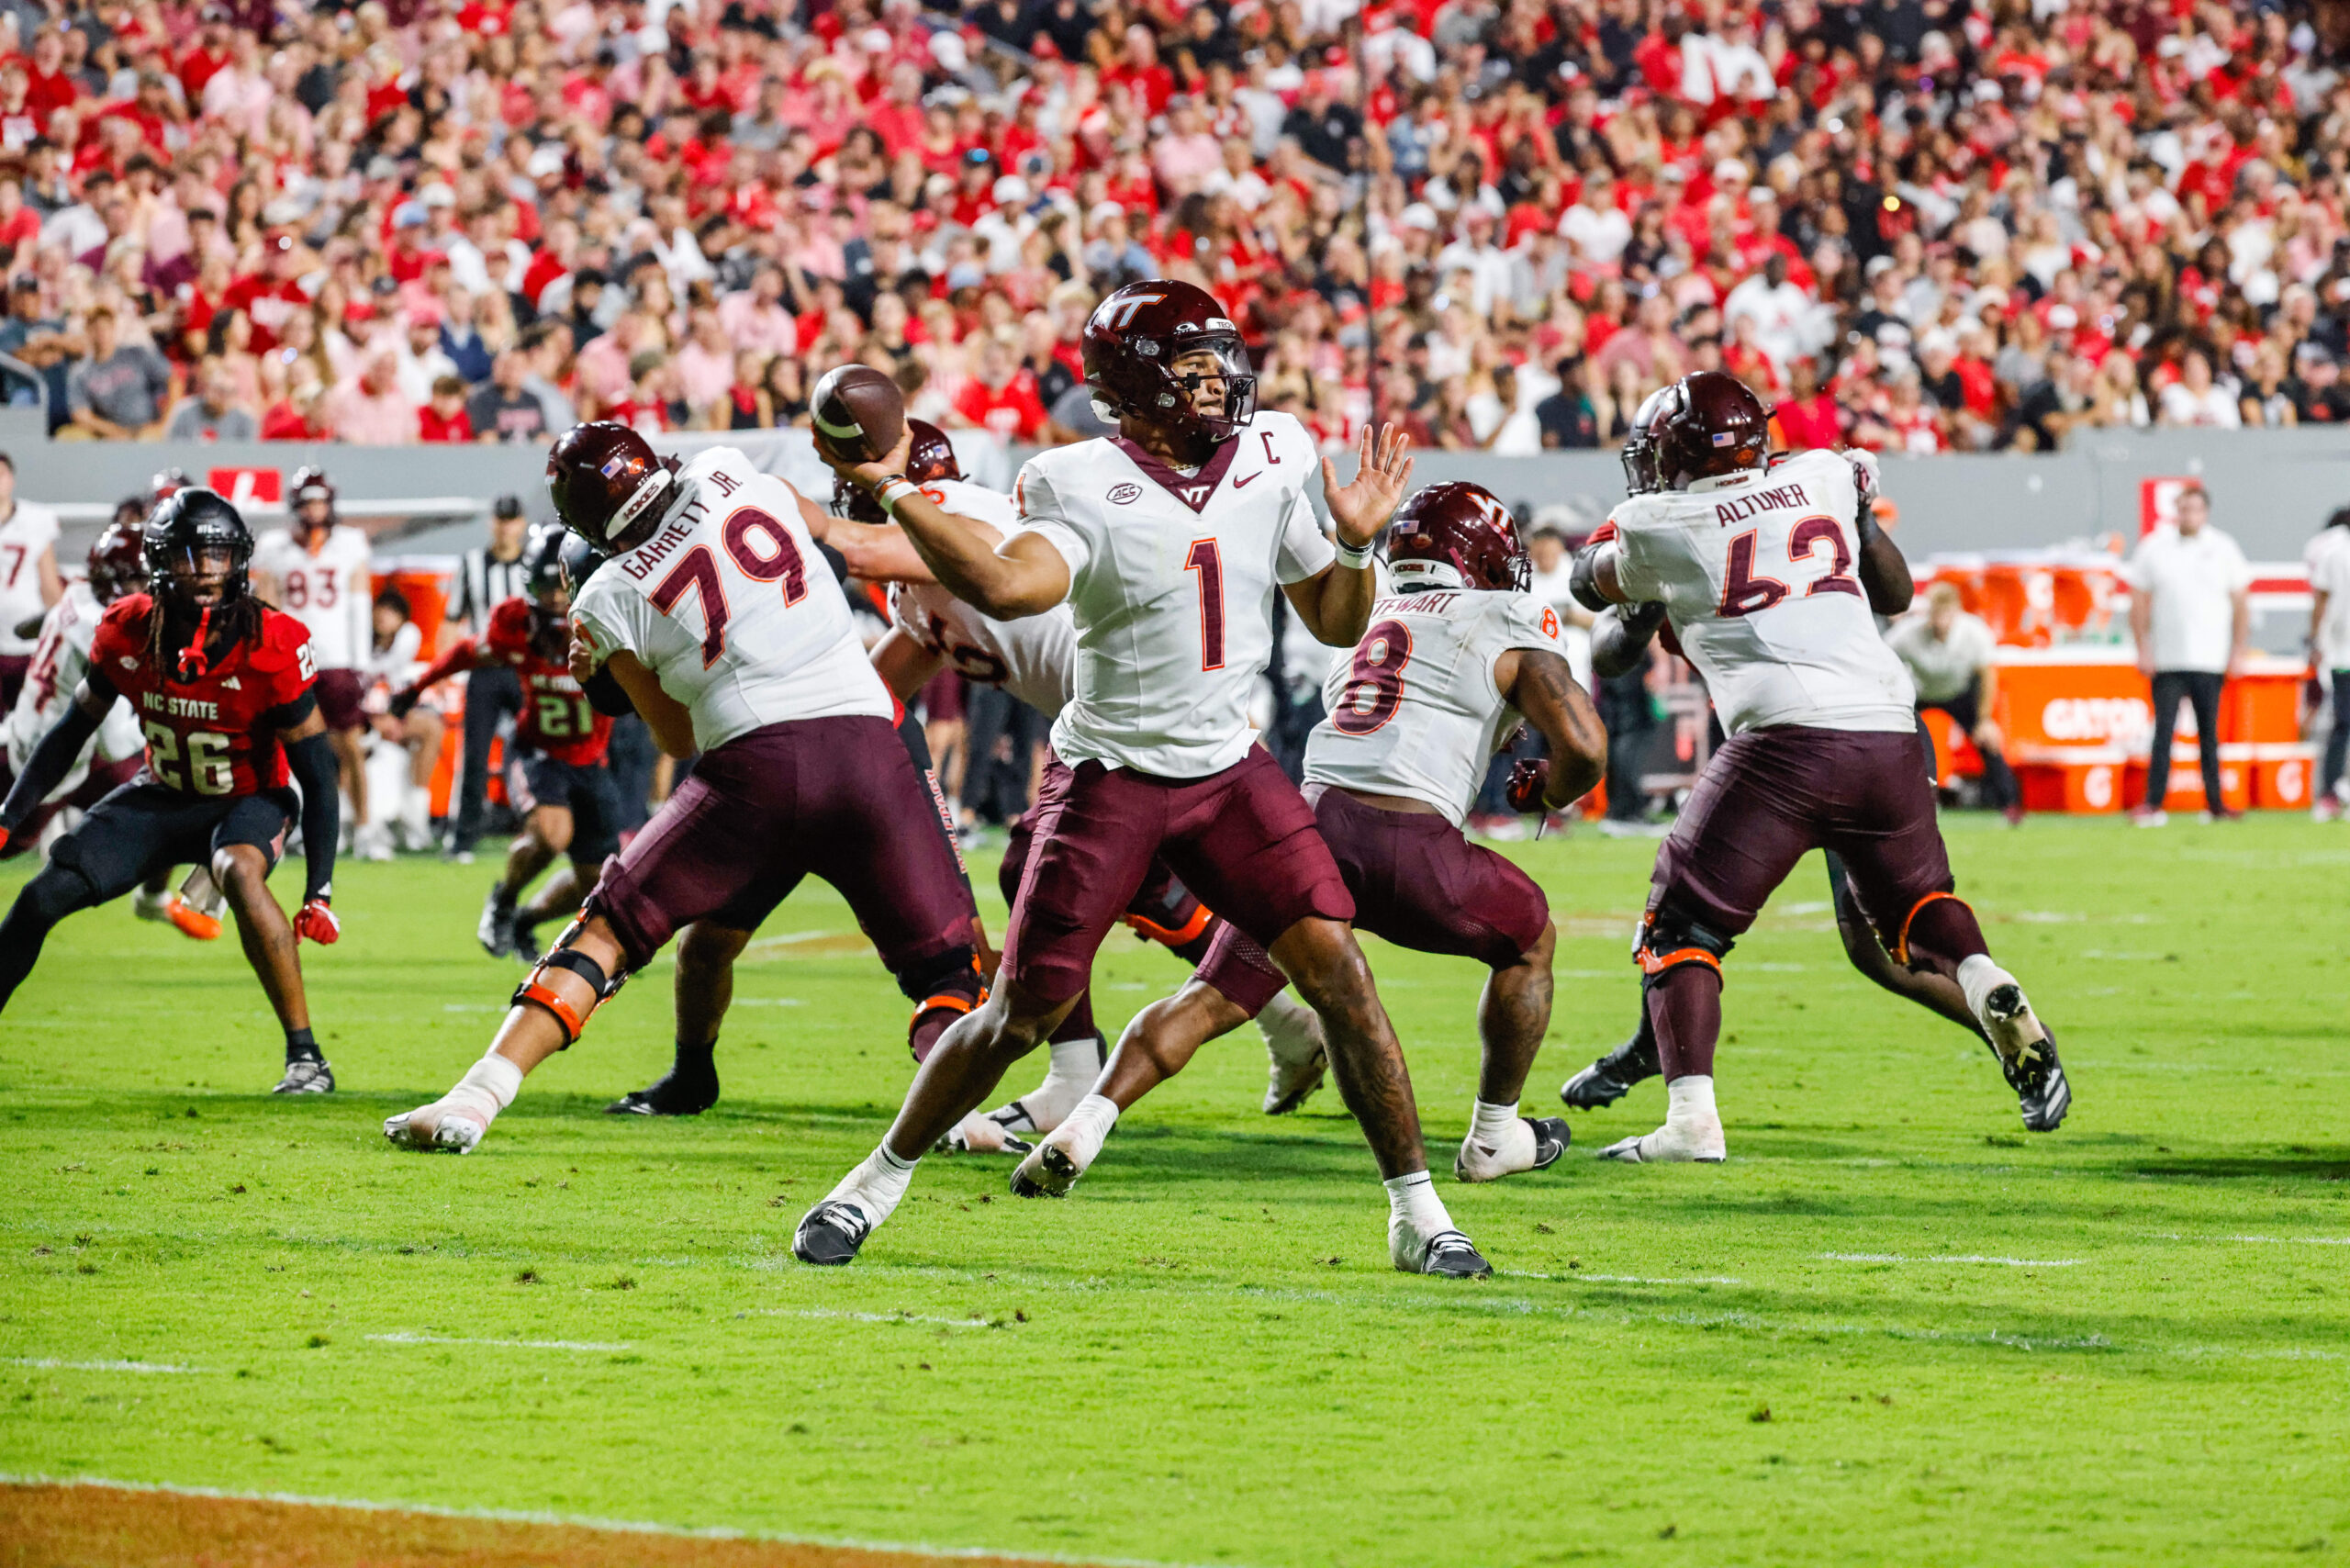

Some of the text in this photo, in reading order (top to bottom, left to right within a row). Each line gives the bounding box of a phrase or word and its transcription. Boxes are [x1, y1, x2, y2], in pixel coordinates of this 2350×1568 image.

[1260, 431, 1281, 464] C
[624, 482, 660, 521] HOKIES
[1113, 486, 1136, 498] ACC
[1179, 486, 1211, 504] VT
[1715, 484, 1811, 528] ALTUNER
[621, 470, 744, 580] GARRETT JR.
[1715, 515, 1864, 618] 62
[285, 567, 339, 610] 83
[647, 505, 809, 672] 79
[1184, 537, 1225, 672] 1
[1371, 592, 1461, 619] TEWART
[1540, 606, 1559, 640] 8
[1332, 618, 1414, 735] 8
[142, 691, 218, 721] NC STATE
[537, 696, 593, 736] 21
[144, 720, 234, 796] 26
